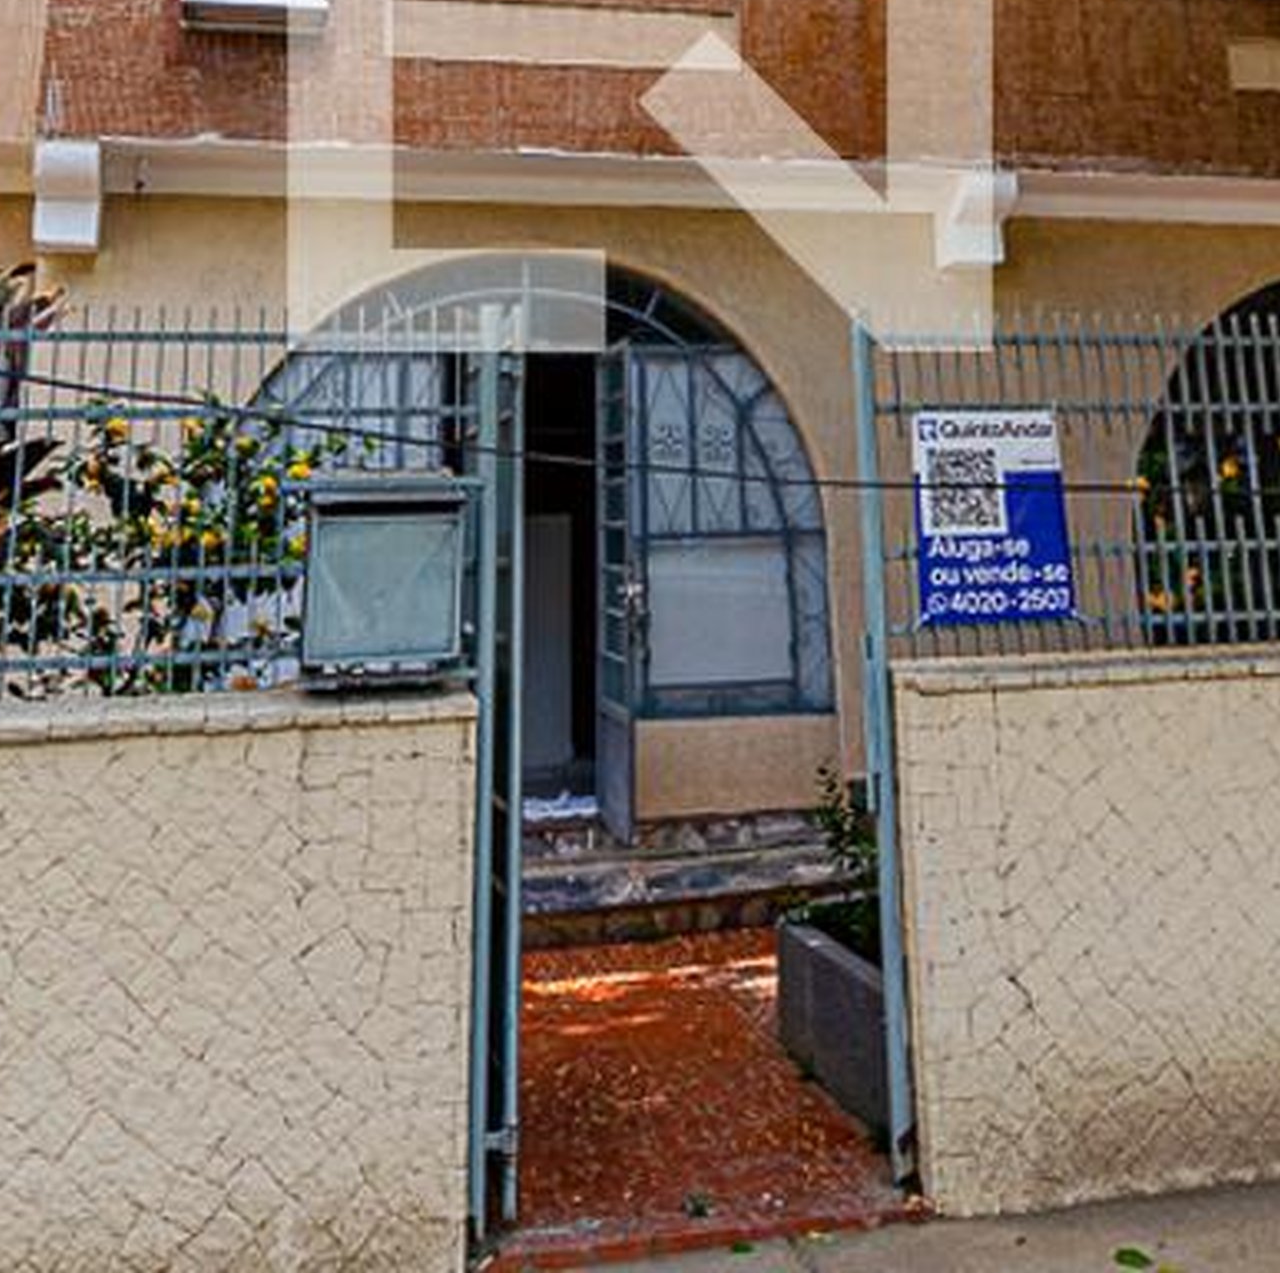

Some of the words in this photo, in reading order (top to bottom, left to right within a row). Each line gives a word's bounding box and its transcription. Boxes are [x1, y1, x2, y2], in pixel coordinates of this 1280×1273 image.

[927, 536, 1031, 562] Aluga-se
[929, 567, 960, 586] ou
[962, 560, 1070, 585] vende-se
